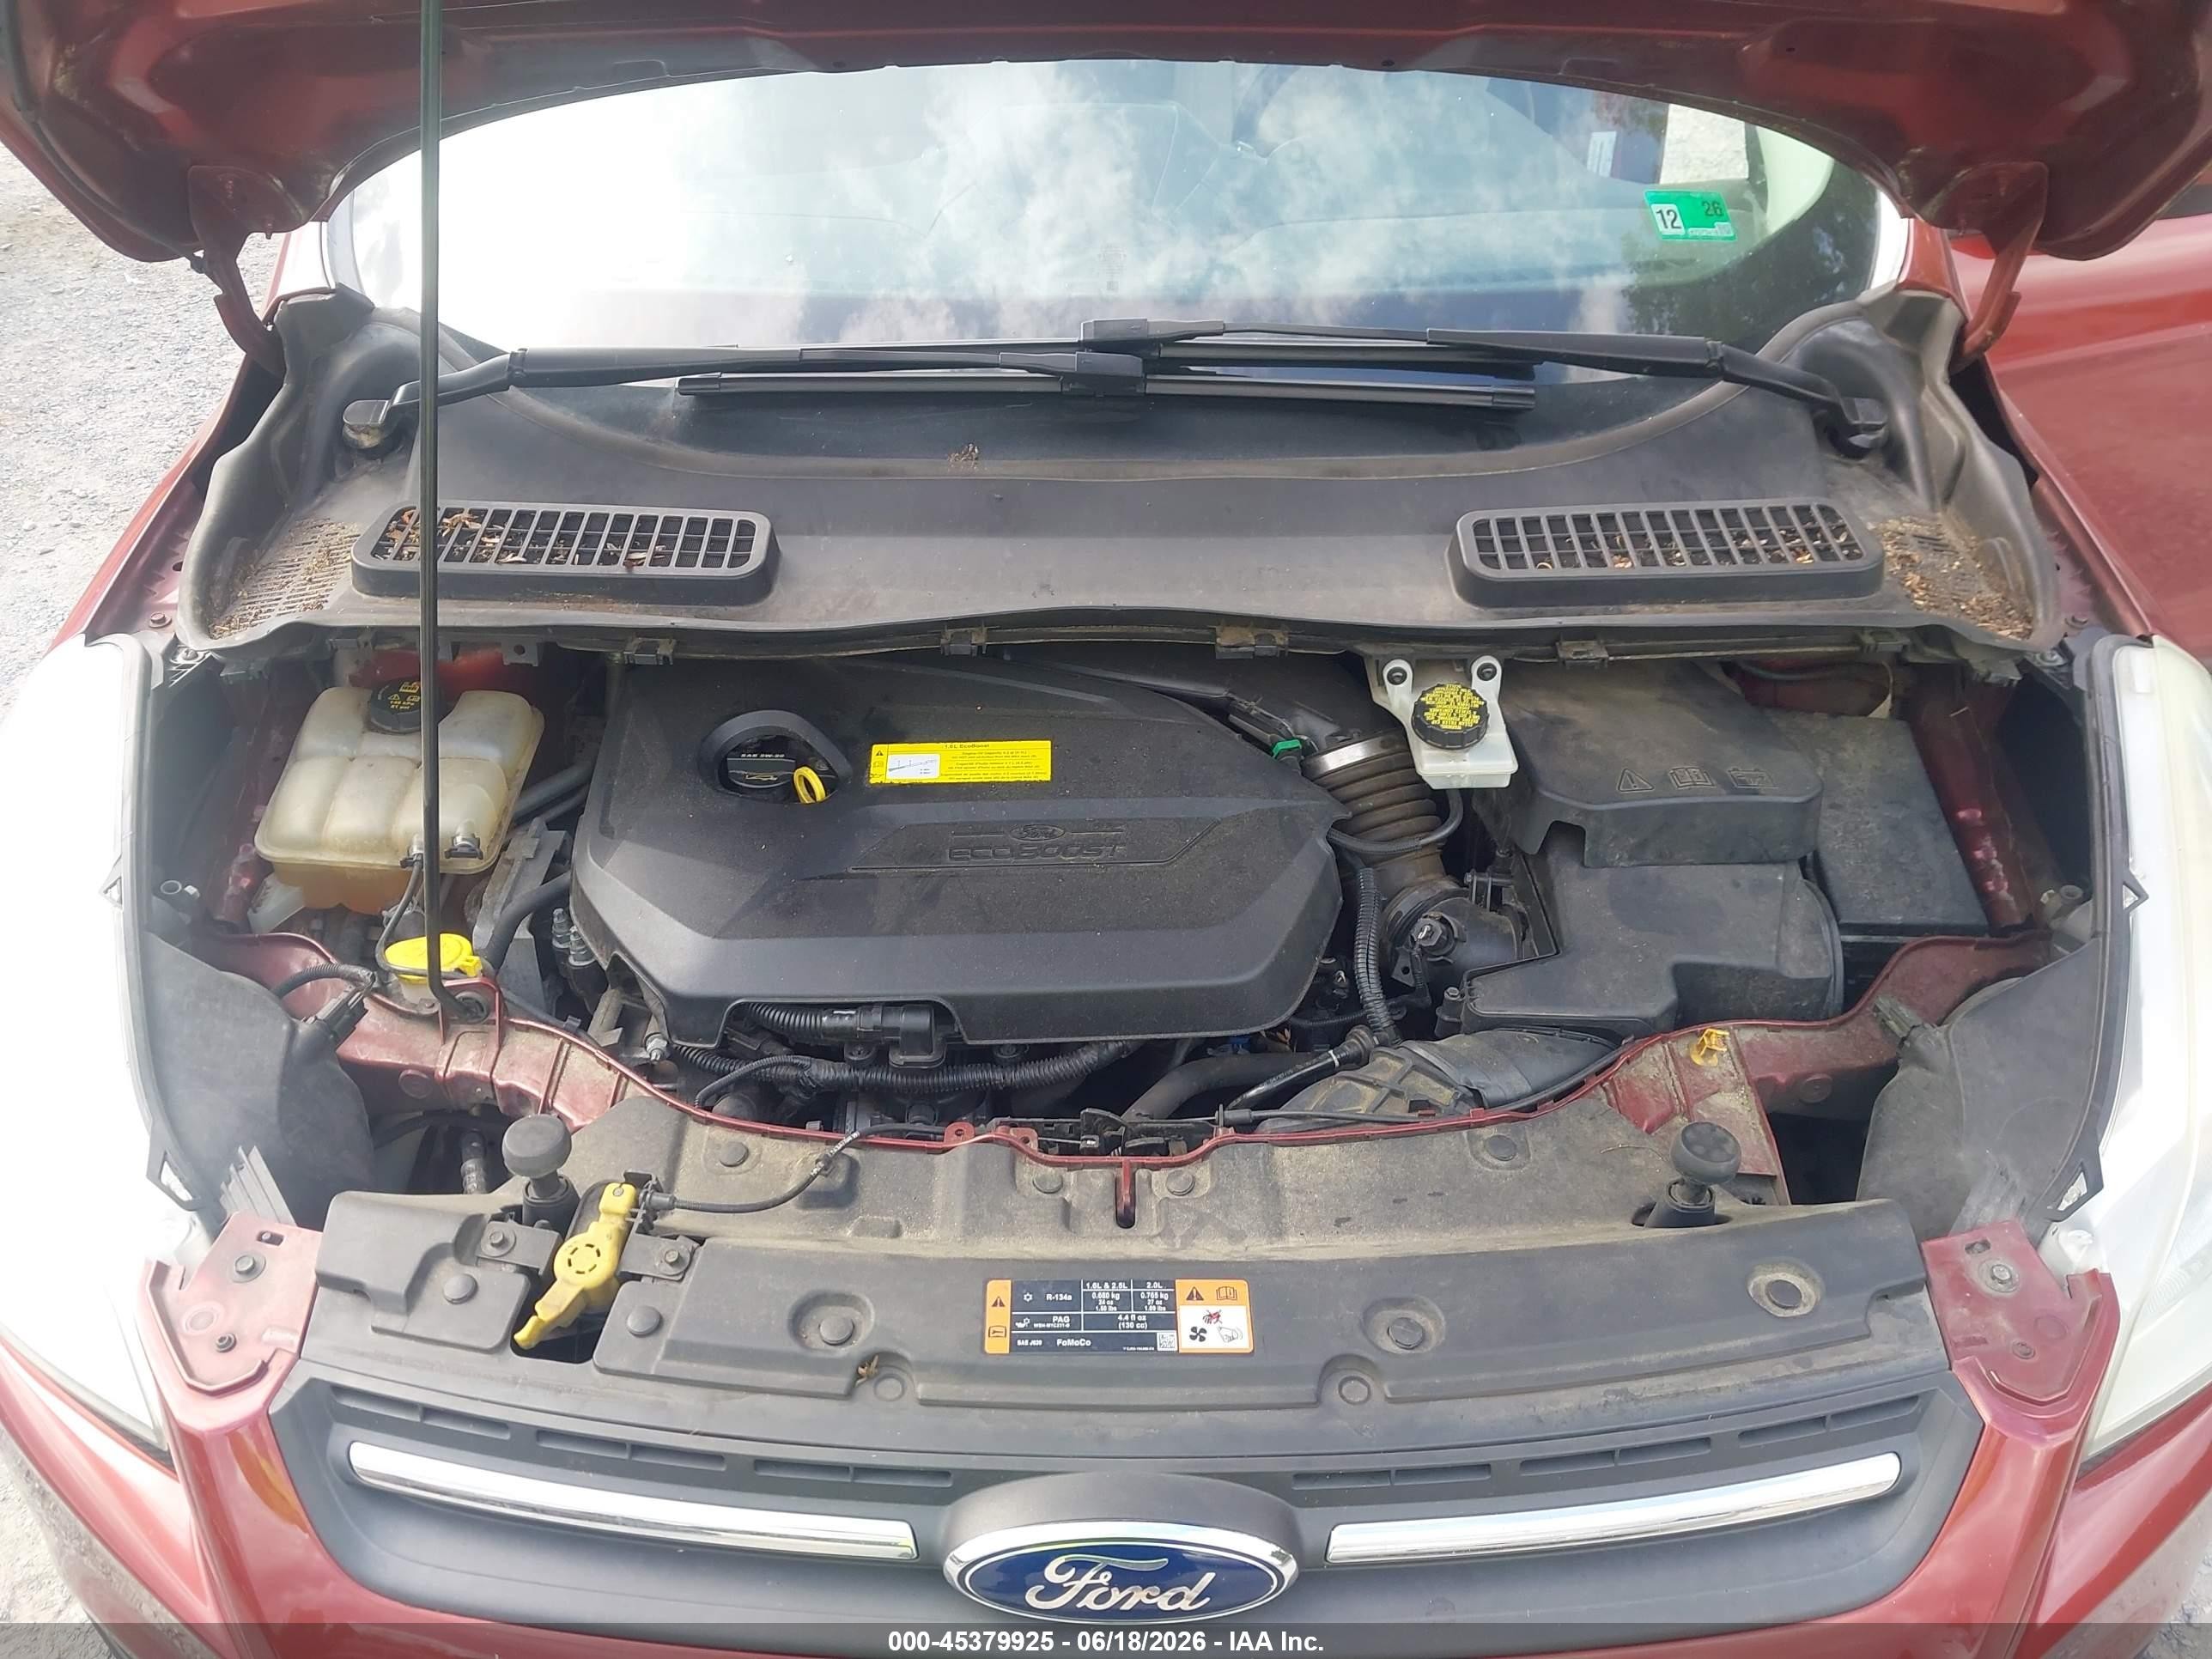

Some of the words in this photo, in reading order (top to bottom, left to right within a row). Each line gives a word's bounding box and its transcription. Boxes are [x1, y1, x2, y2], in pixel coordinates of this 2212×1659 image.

[1701, 200, 1723, 216] 26
[1656, 210, 1682, 229] 12
[1111, 1291, 1120, 1300] kg
[1160, 1291, 1169, 1300] kg
[1056, 1338, 1092, 1346] FoMoCo
[1024, 1553, 1217, 1612] Ford
